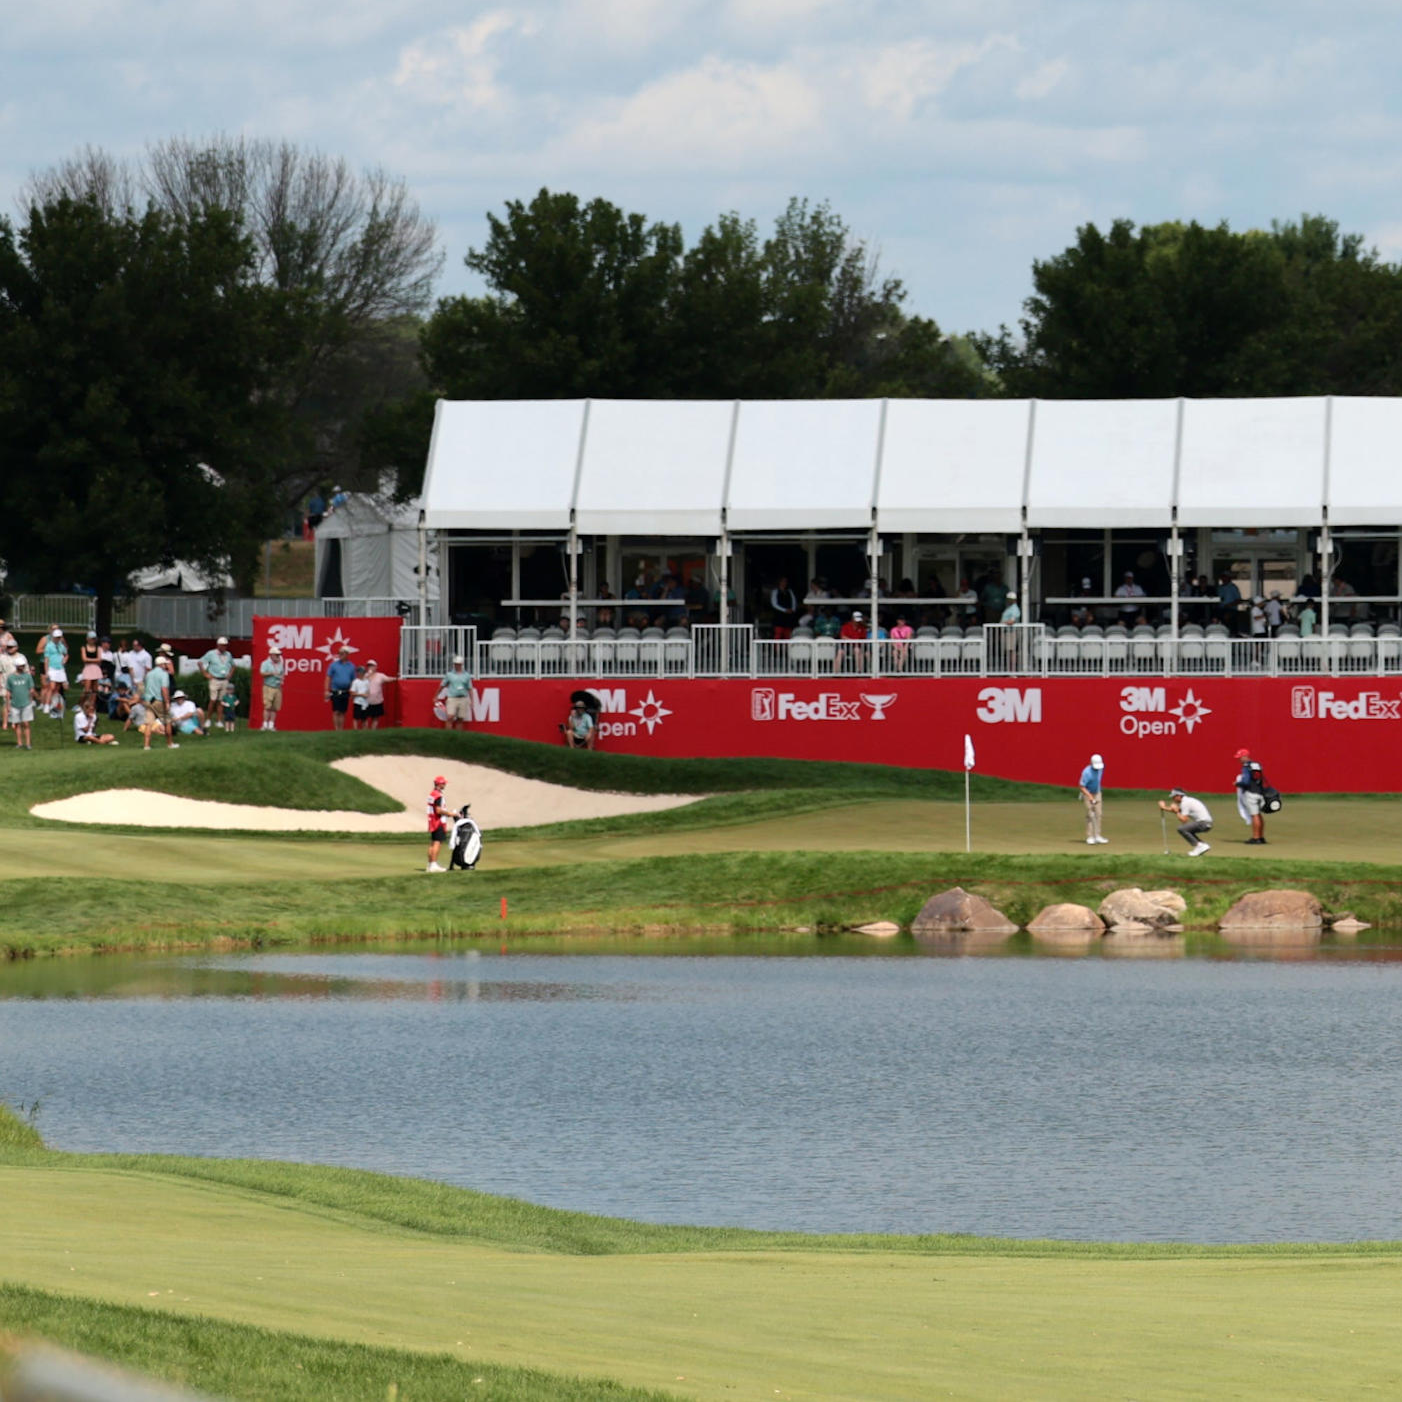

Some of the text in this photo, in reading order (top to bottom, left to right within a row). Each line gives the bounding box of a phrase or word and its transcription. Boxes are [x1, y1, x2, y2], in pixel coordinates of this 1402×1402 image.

[266, 624, 314, 650] 3M
[281, 656, 322, 676] pen
[778, 692, 861, 721] FedEx
[977, 687, 1042, 723] 3M
[1120, 686, 1166, 712] 3M
[1317, 691, 1401, 720] FedEx
[598, 721, 637, 741] pen
[1120, 715, 1177, 739] Open
